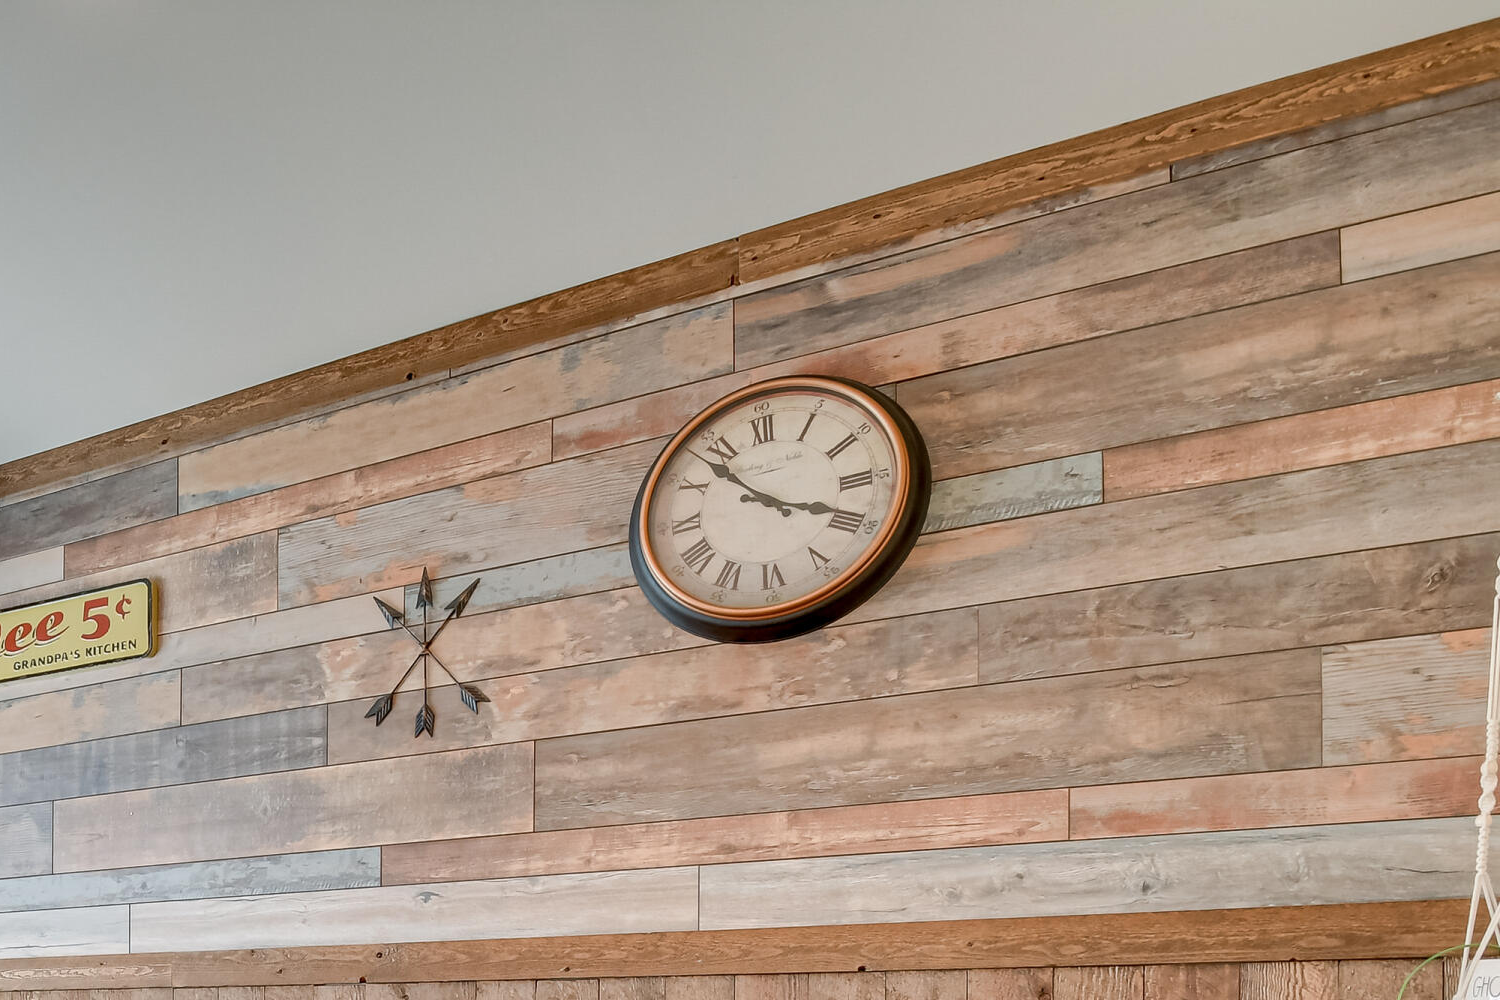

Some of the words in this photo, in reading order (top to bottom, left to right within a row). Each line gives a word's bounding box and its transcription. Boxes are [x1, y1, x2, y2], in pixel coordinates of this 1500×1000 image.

[754, 401, 770, 413] 60
[748, 413, 777, 447] XII
[796, 413, 816, 442] I
[858, 422, 871, 435] 10
[706, 434, 739, 465] XI
[824, 432, 859, 461] II
[678, 476, 711, 496] X
[839, 468, 873, 493] III
[879, 468, 889, 479] 15
[671, 511, 701, 536] IX
[680, 537, 716, 577] VIII
[807, 546, 831, 571] V
[712, 560, 741, 590] VII
[760, 563, 787, 590] VI
[13, 649, 80, 671] GRANDPA'S
[86, 639, 137, 657] KITCHEN
